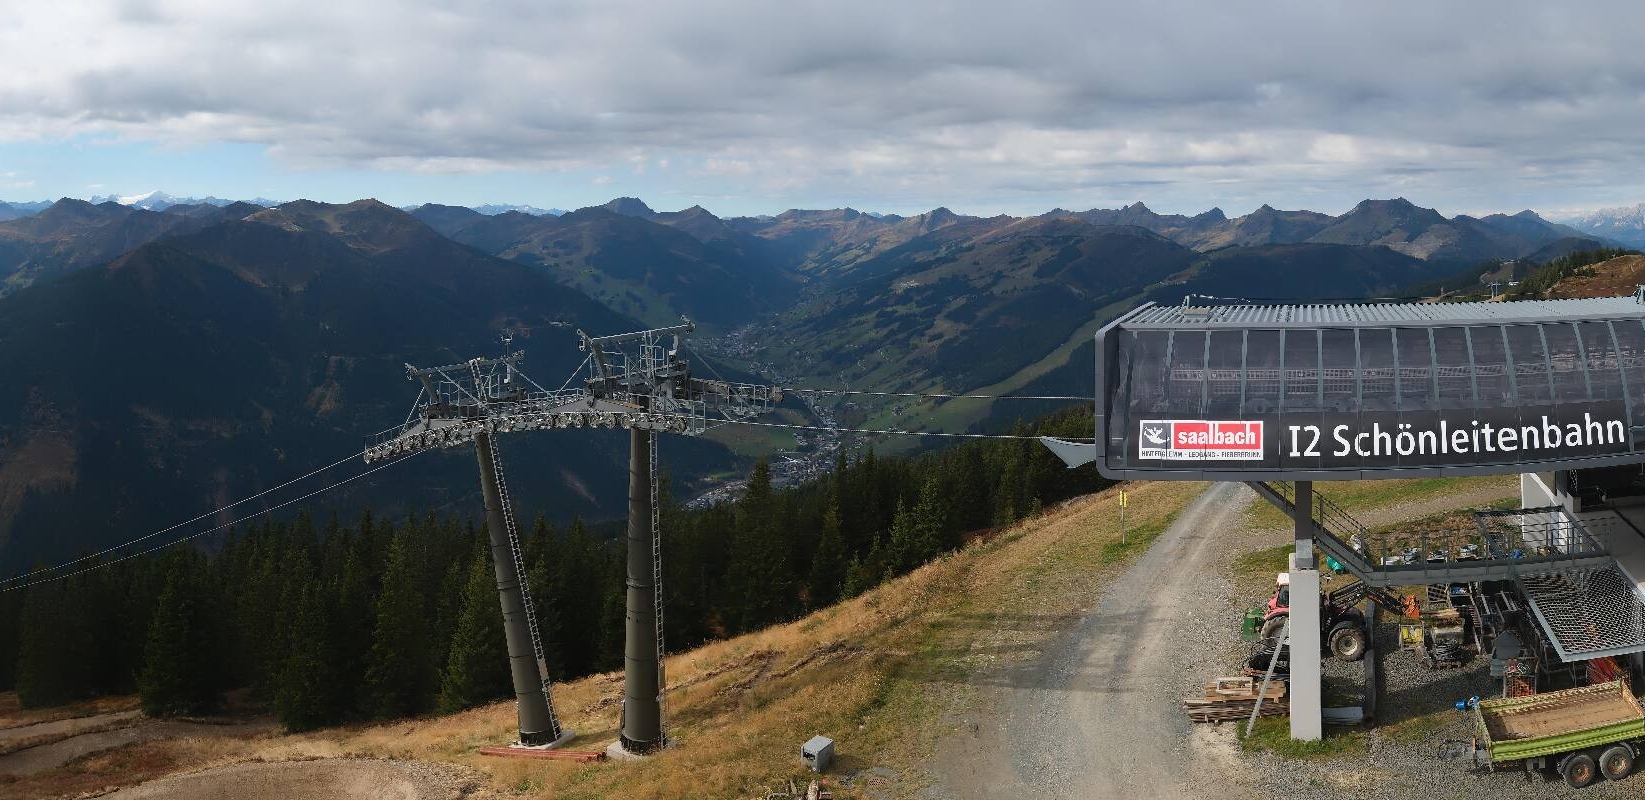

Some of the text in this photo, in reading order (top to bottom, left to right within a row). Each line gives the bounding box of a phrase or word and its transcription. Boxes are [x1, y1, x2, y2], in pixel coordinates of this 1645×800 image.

[1177, 421, 1256, 445] saalbach
[1288, 412, 1625, 457] I2 Schönleitenbahn
